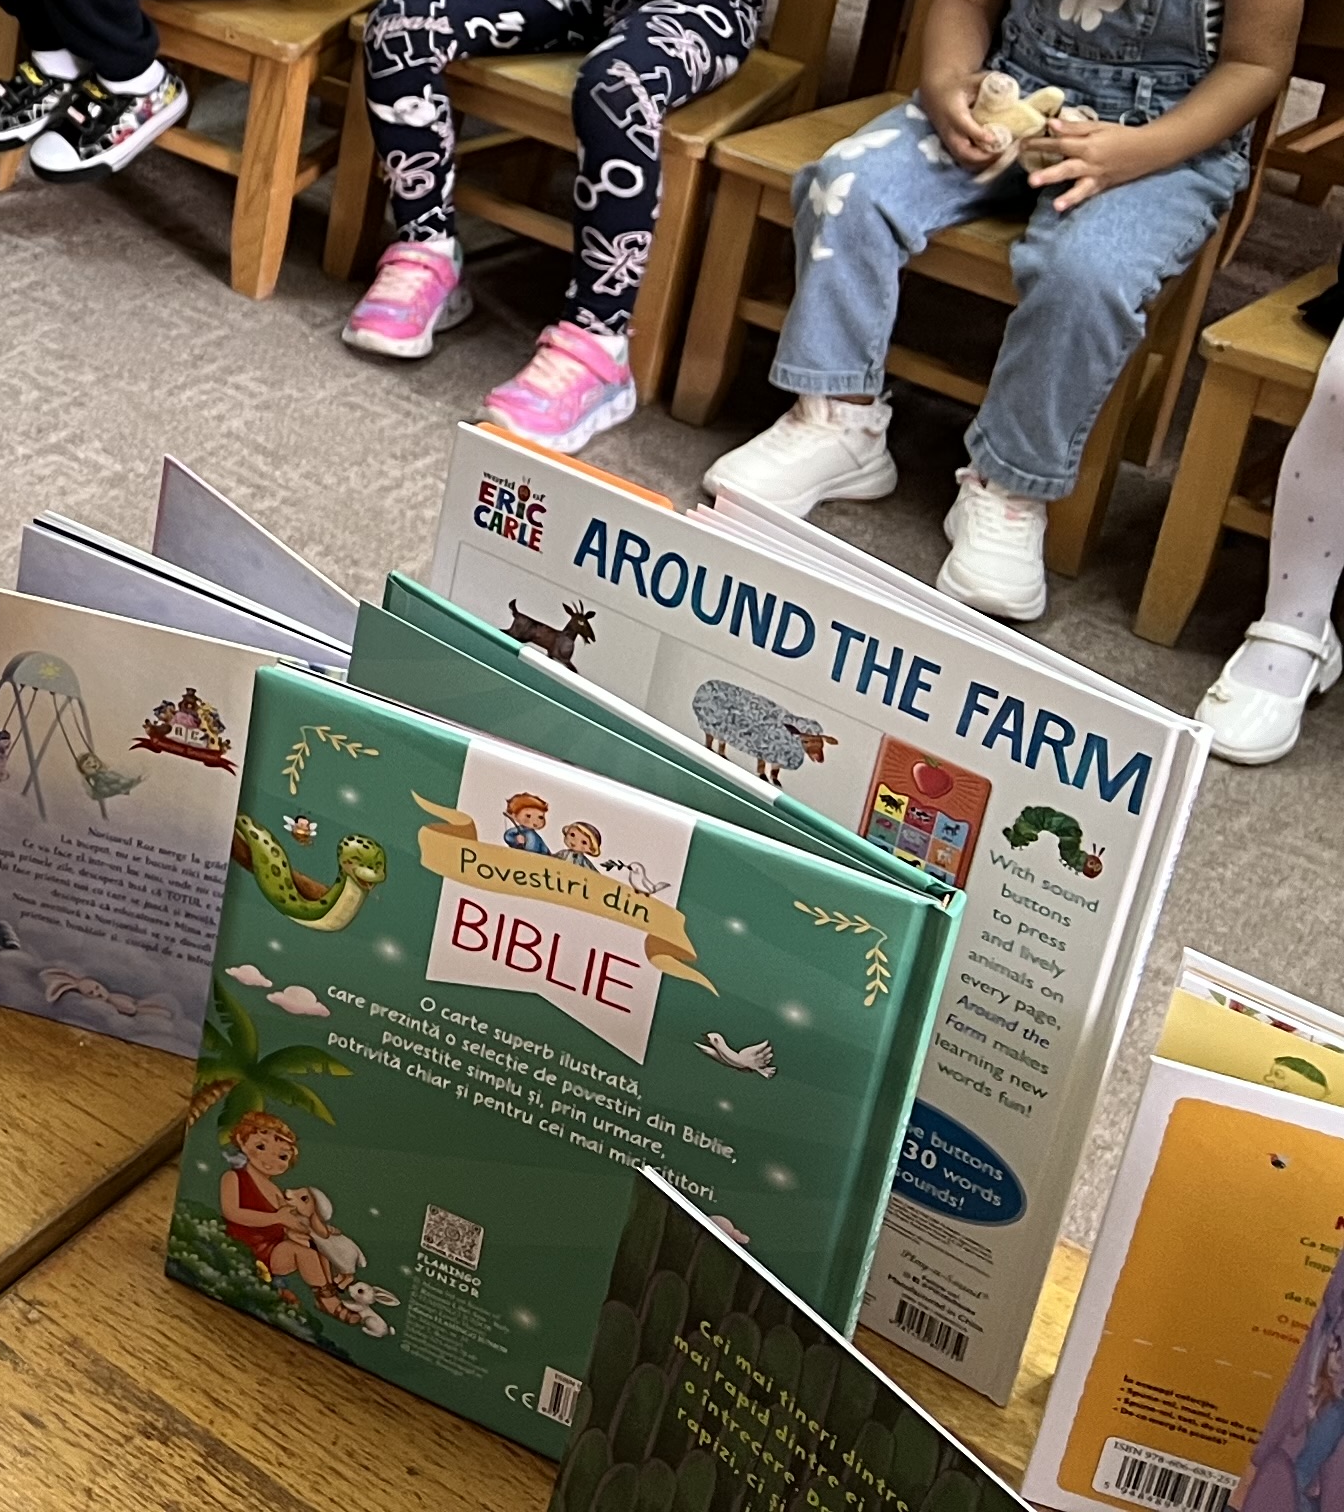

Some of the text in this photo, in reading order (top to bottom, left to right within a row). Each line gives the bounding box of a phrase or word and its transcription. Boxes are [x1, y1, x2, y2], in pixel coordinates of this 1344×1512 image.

[483, 471, 516, 491] world
[473, 504, 543, 552] CARLE
[572, 517, 1153, 816] AROUND THE FARM
[460, 847, 650, 923] Povestiri din
[989, 849, 1100, 913] With sound
[1000, 882, 1071, 927] buttons
[451, 897, 641, 1014] BIBLIE
[980, 930, 1066, 979] and lively
[992, 908, 1066, 952] to press
[960, 972, 1061, 1031] every page,
[967, 950, 1064, 1003] animals on
[419, 996, 642, 1100] O carte superb ilustrată,
[944, 1013, 1049, 1076] Farm makes
[955, 994, 1050, 1049] Around the
[327, 985, 737, 1164] care prezintă o selecție de povestiri din Biblie,
[327, 1031, 401, 1070] potrivită
[405, 1064, 452, 1089] chiar
[455, 1084, 469, 1099] și
[472, 1091, 533, 1125] pentru
[538, 1119, 564, 1138] cei
[569, 1131, 603, 1154] mai
[381, 1030, 462, 1071] povestite
[465, 1065, 522, 1097] simplu
[550, 1099, 587, 1124] prin
[592, 1116, 665, 1159] urmare,
[934, 1032, 1048, 1099] learning new
[937, 1061, 1032, 1118] words fun!
[902, 1139, 1001, 1207] 30 words
[930, 1131, 1009, 1181] buttons
[414, 1262, 480, 1298] JUNIOR
[416, 1251, 482, 1287] FLAMINGO
[673, 1334, 710, 1372] mai
[714, 1370, 770, 1427] rapid
[774, 1424, 839, 1488] dintre
[677, 1407, 740, 1475] rapizi,
[684, 1381, 799, 1492] o întrecere.
[699, 1320, 909, 1512] Cei mai tineri dintre
